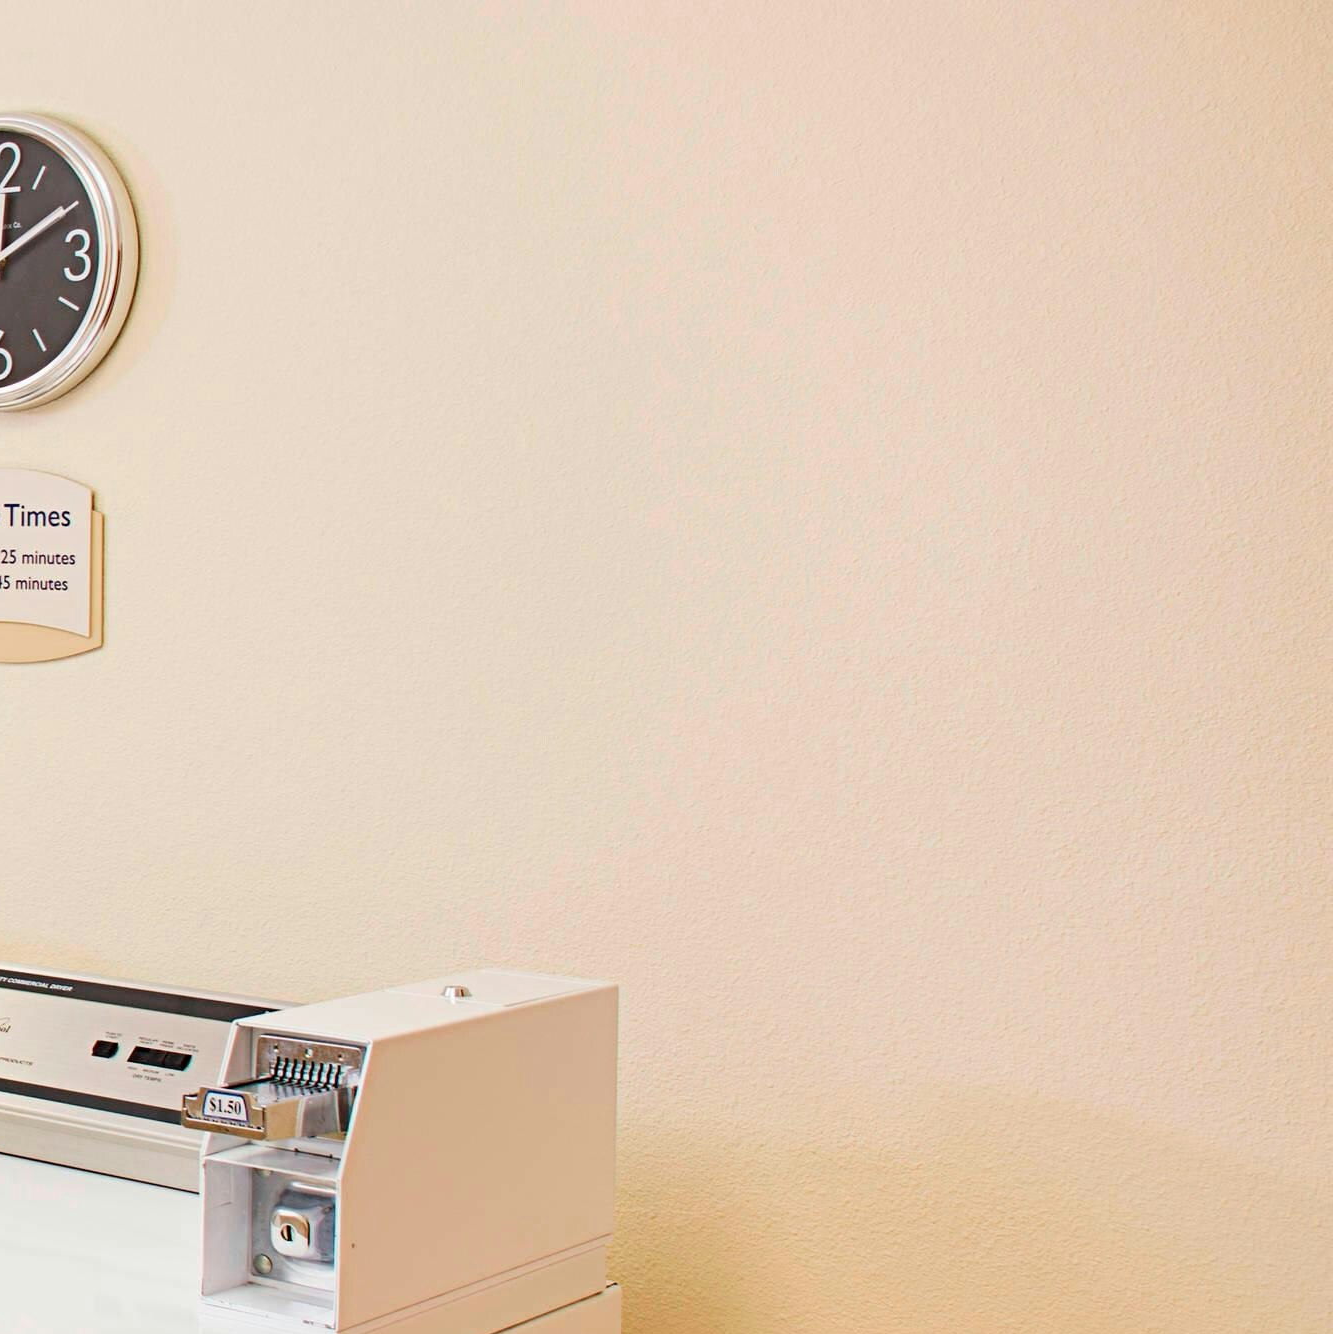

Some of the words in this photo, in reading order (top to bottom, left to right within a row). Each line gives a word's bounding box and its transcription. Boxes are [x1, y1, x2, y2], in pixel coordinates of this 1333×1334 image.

[63, 228, 91, 282] 3
[3, 503, 71, 527] Times
[0, 549, 17, 565] 25
[21, 551, 76, 565] minutes
[15, 577, 69, 591] minutes
[7, 978, 49, 988] COMMERCIAL
[49, 984, 73, 992] DRYER
[209, 1096, 241, 1115] $1.50
